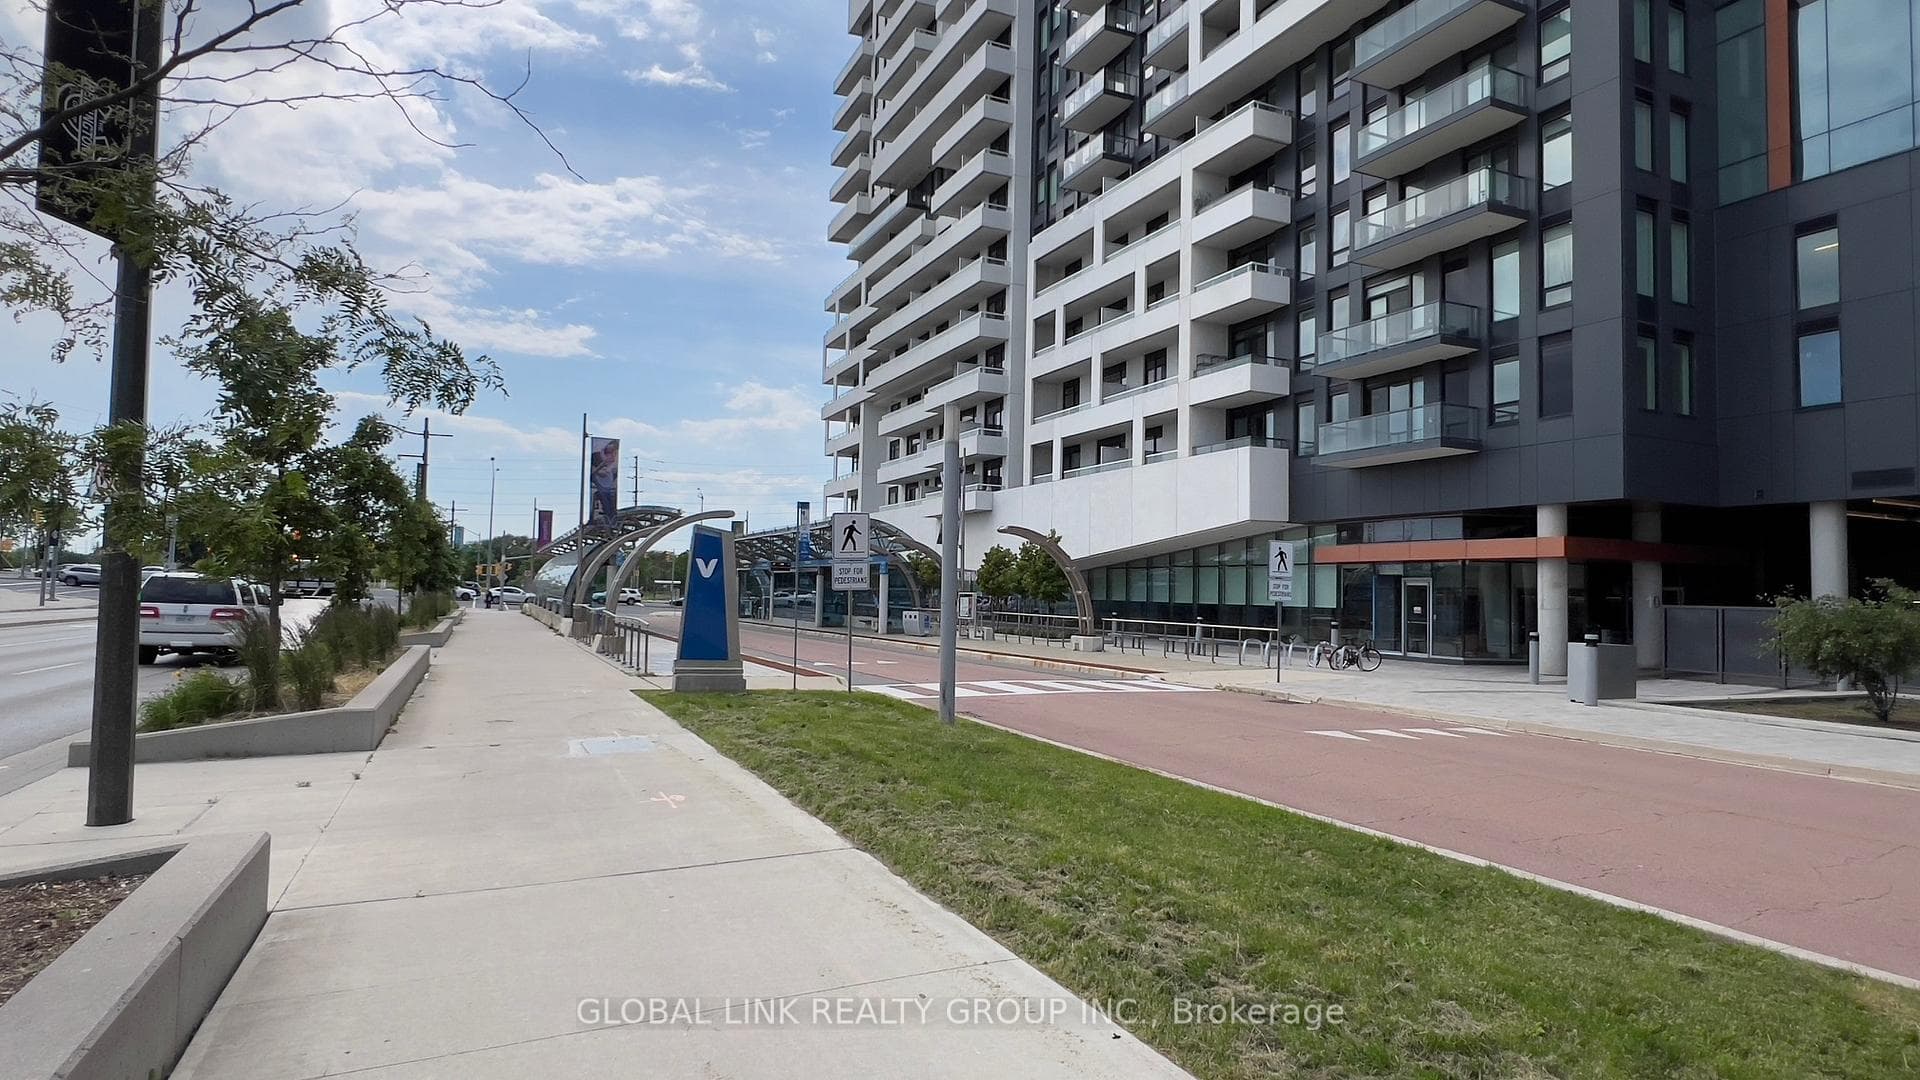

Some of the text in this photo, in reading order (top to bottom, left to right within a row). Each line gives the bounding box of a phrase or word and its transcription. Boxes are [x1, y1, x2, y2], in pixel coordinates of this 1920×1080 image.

[695, 557, 719, 578] V
[839, 567, 864, 575] STOP FOR
[834, 576, 867, 585] PEDESTRIANS
